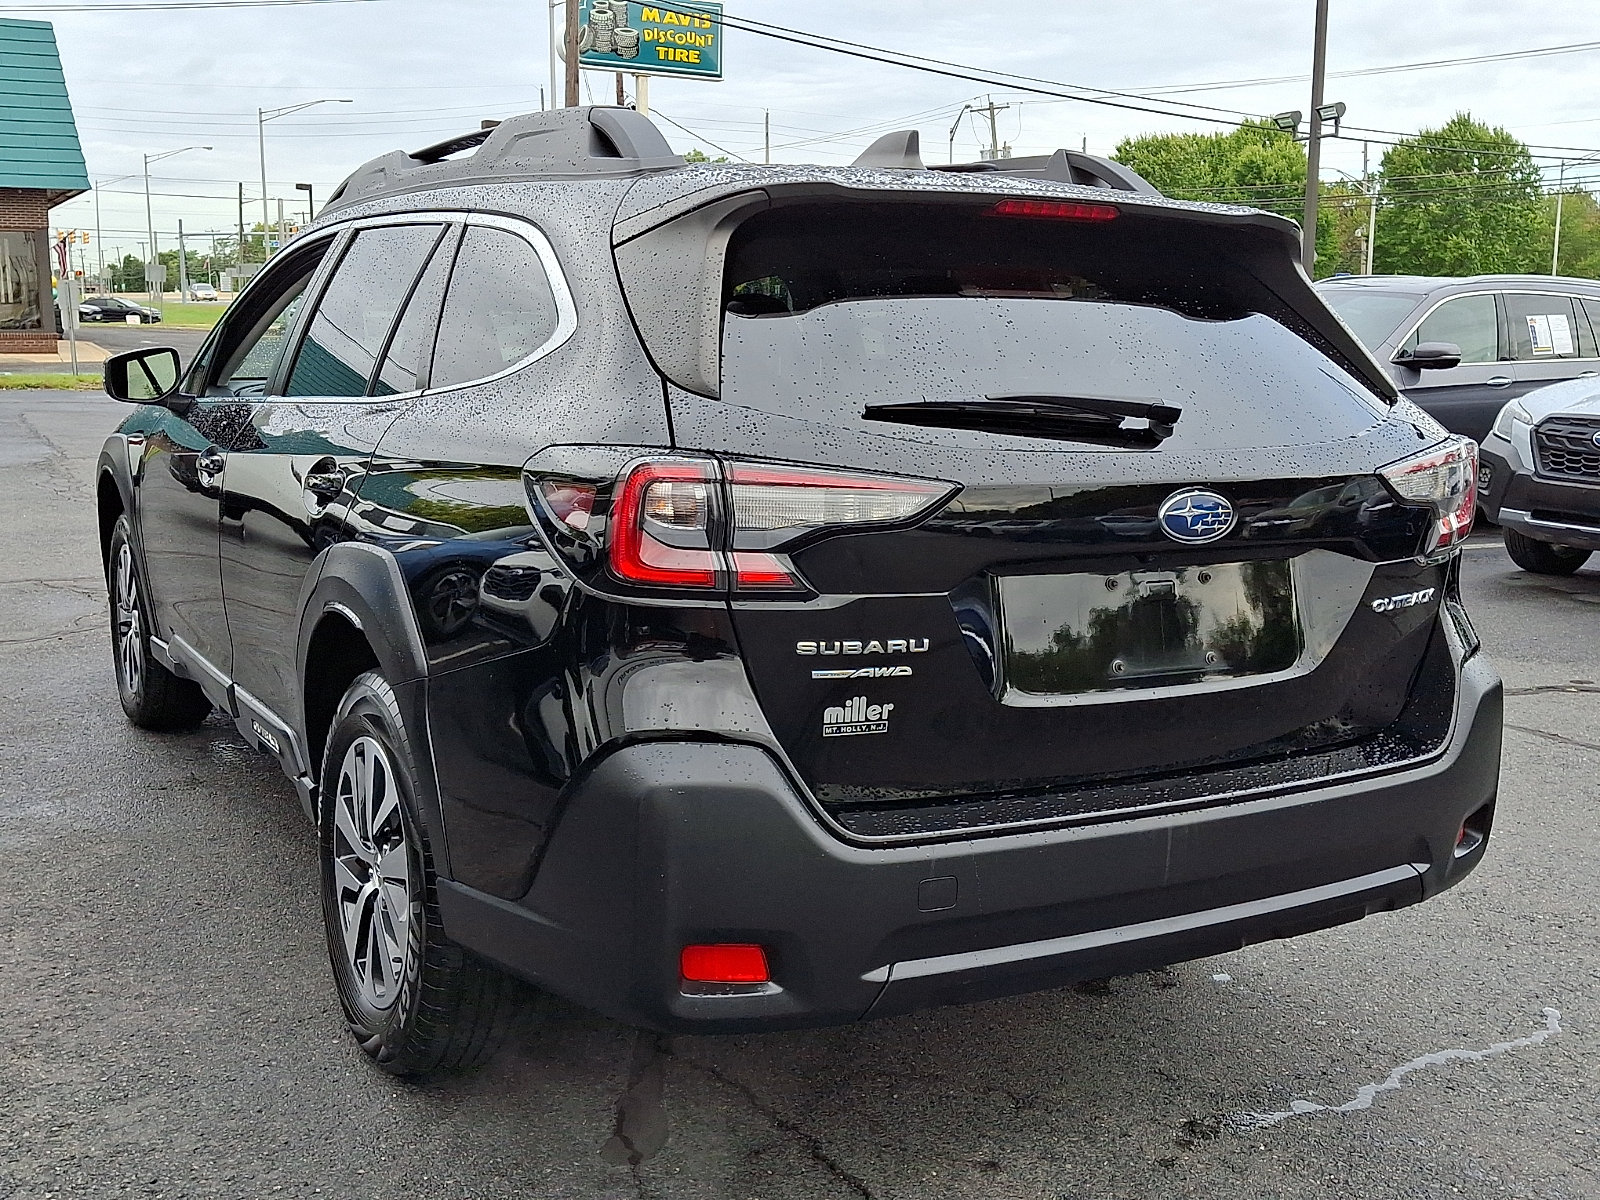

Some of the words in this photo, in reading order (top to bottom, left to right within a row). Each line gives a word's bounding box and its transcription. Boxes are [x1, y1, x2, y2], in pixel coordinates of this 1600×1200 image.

[641, 6, 712, 29] MAVIS
[643, 27, 715, 48] DISCOUNT
[655, 46, 701, 63] TIRE
[796, 638, 930, 655] SUBARU
[850, 666, 912, 679] AWD
[823, 695, 894, 723] miller
[840, 725, 869, 733] HOLLY,
[870, 723, 886, 731] N.J.
